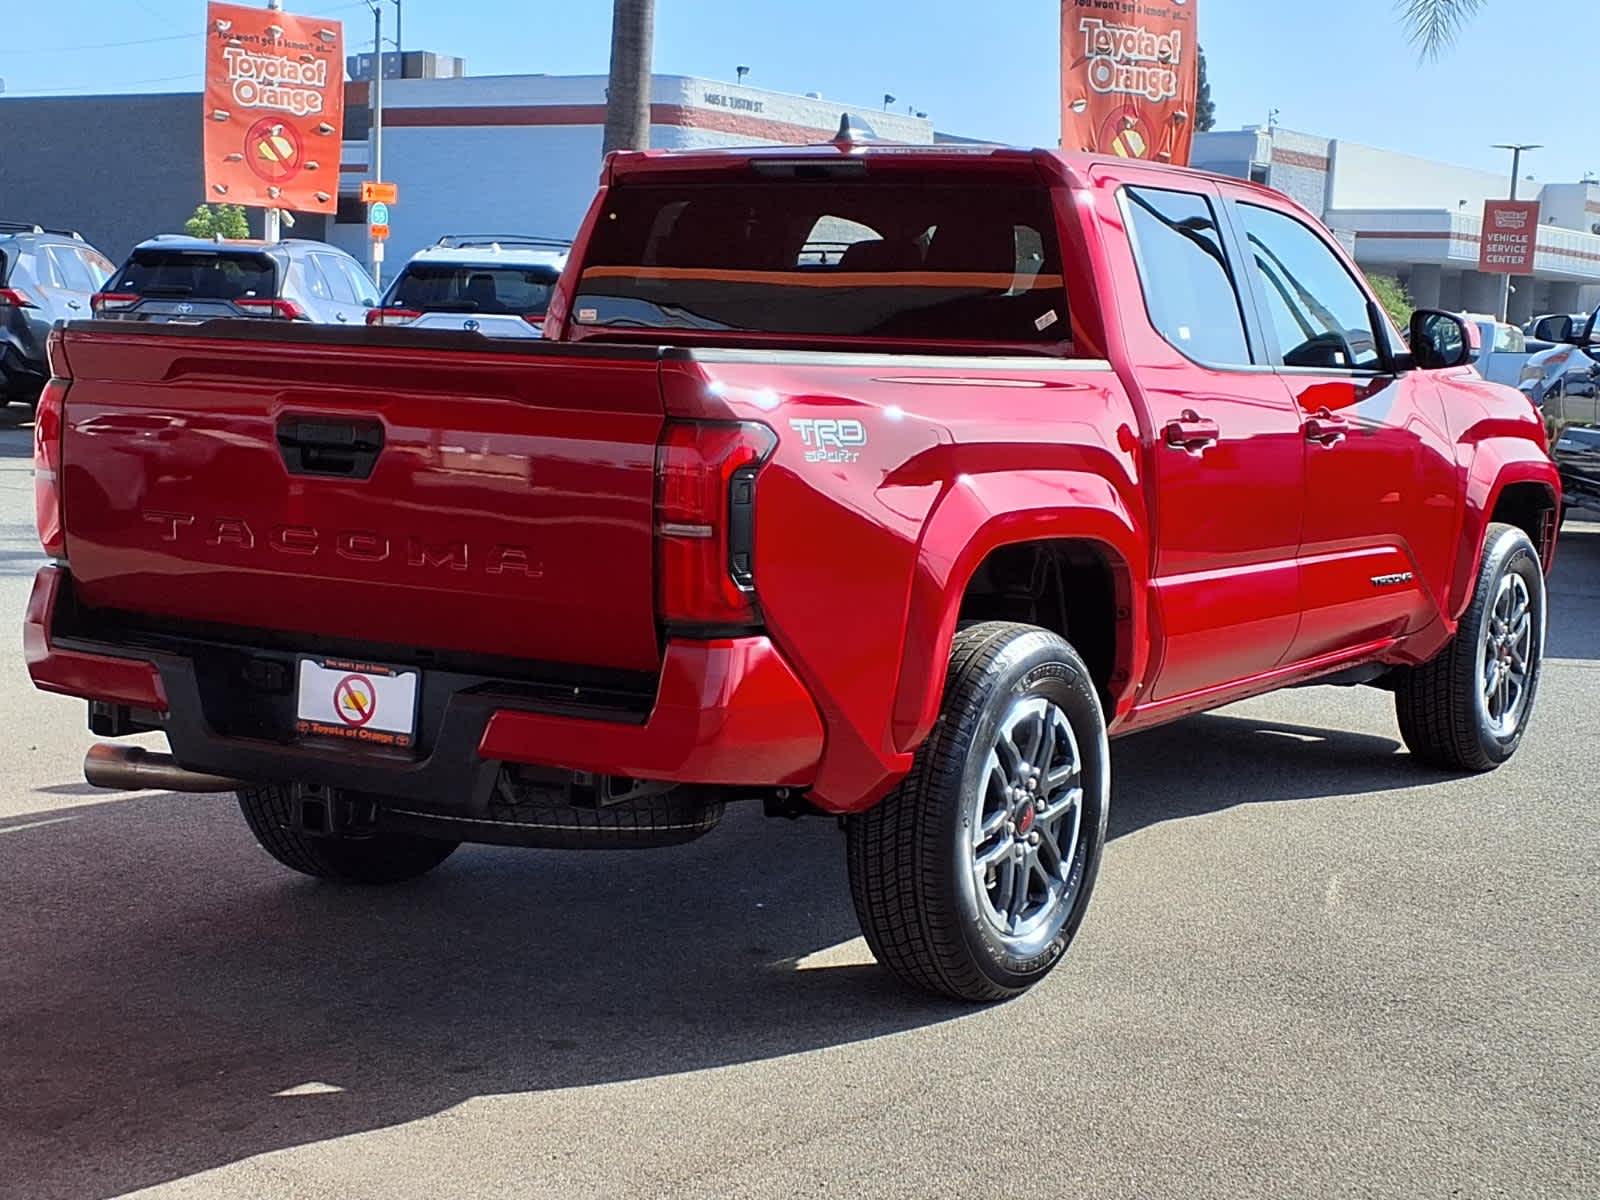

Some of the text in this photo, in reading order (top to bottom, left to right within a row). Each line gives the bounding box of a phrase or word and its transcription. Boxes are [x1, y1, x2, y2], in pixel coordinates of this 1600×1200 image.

[1080, 17, 1181, 65] Toyota of
[223, 47, 327, 87] Toyota of
[1088, 55, 1177, 103] Orange
[233, 78, 323, 116] Orange
[1487, 243, 1528, 253] SERVICE
[1488, 233, 1529, 243] VEHICLE
[1486, 254, 1524, 264] CENTER
[788, 418, 867, 449] TRD
[804, 450, 860, 463] SPORT
[142, 510, 544, 577] TACOMA
[311, 722, 394, 744] Toyota of Orange
